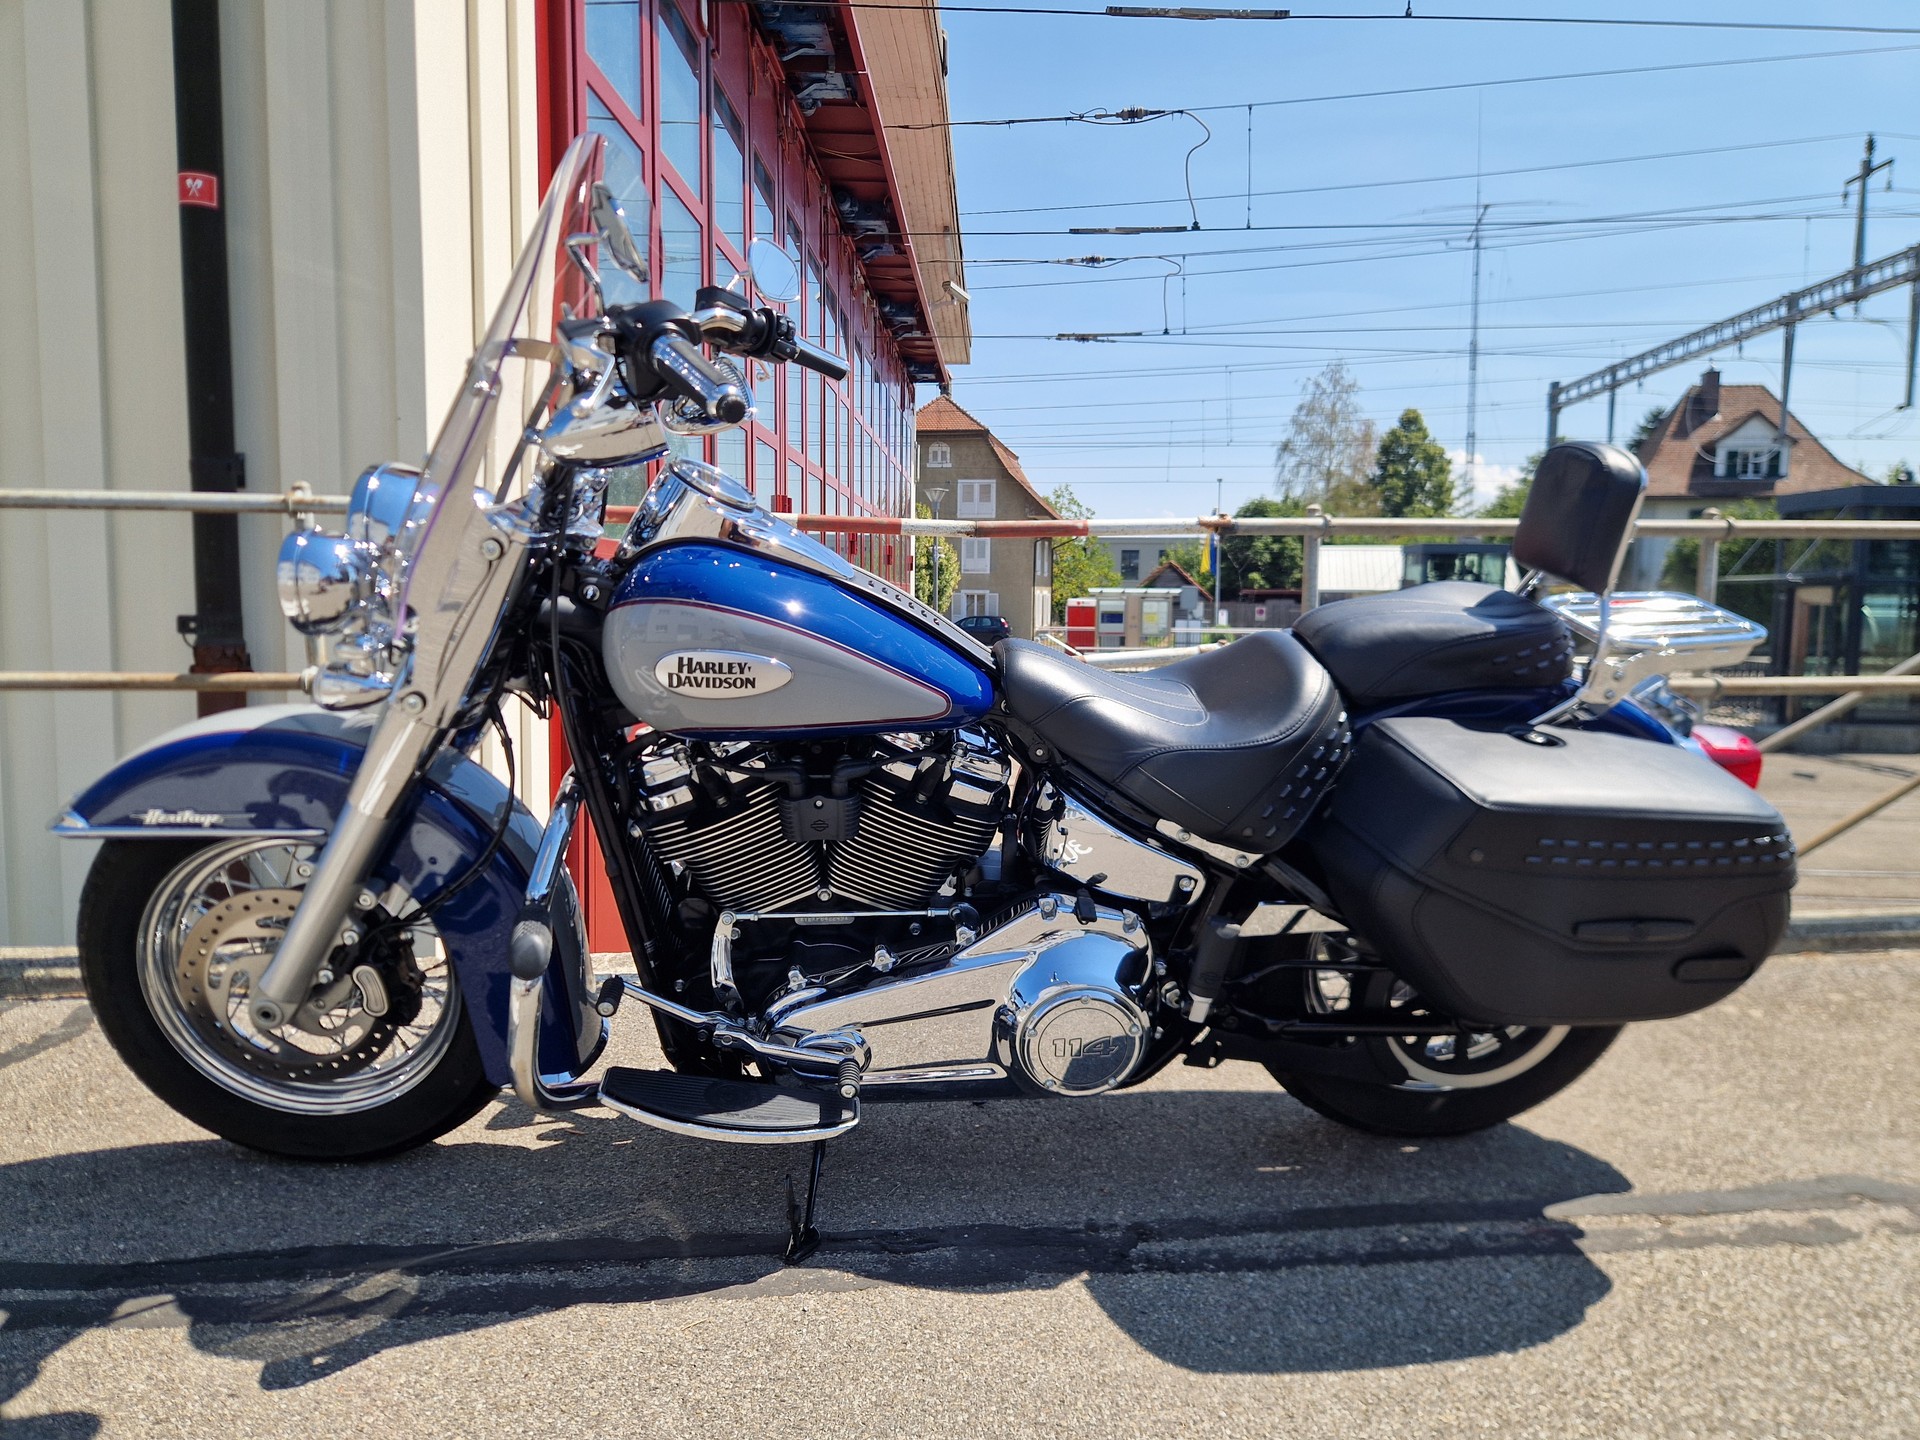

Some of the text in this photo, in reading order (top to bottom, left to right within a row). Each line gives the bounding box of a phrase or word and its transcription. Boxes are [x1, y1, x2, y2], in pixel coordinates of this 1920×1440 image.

[667, 672, 757, 689] DAVIDSON
[142, 808, 224, 828] Heritage
[1052, 1035, 1119, 1058] 114
